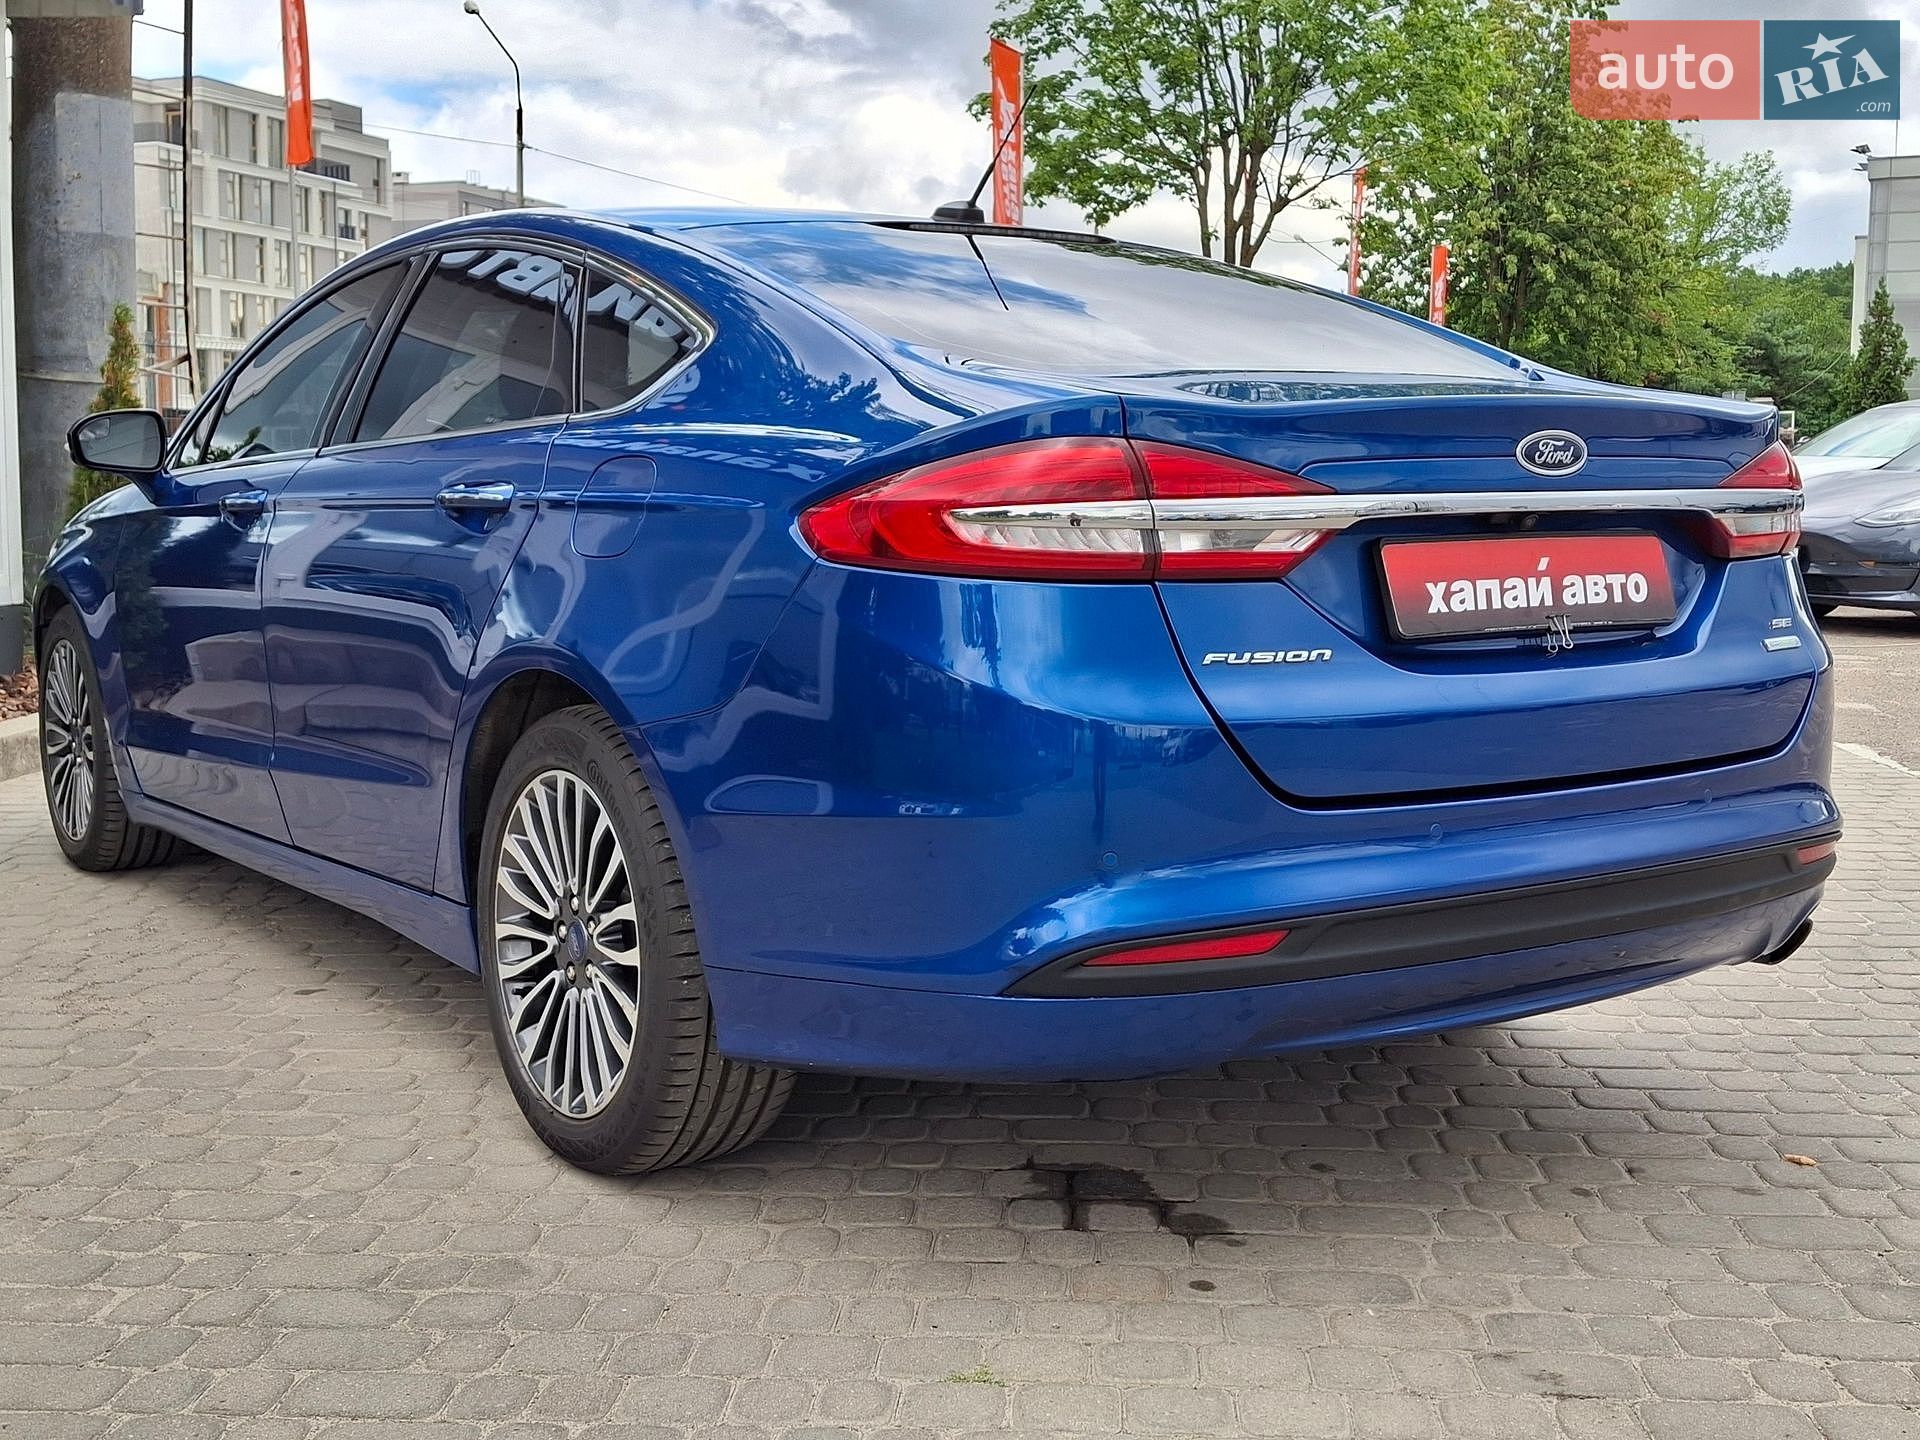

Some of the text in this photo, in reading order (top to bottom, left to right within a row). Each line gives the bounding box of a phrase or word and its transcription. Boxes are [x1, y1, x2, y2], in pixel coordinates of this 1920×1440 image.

[1534, 439, 1575, 464] Ford
[1425, 556, 1649, 614] хапай авто
[1769, 617, 1793, 629] SE
[1202, 648, 1333, 665] FUSION
